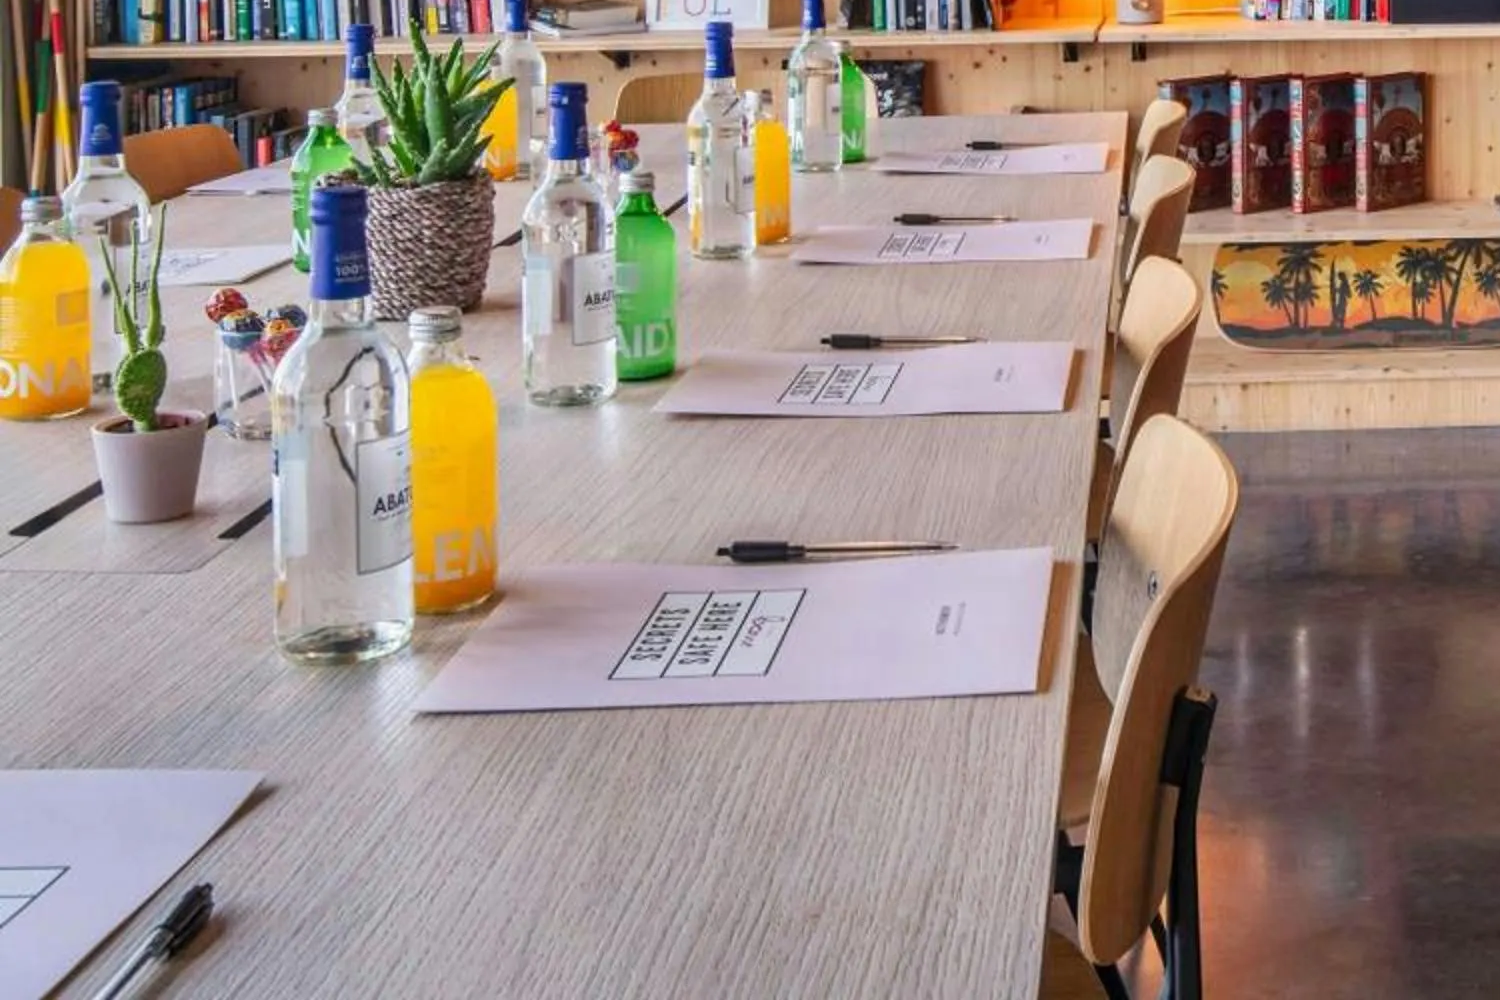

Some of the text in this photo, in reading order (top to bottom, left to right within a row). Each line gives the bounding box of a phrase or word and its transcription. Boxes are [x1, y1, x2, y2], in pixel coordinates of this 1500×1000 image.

[628, 608, 690, 660] SECRETS
[676, 601, 741, 664] SAFE HERE
